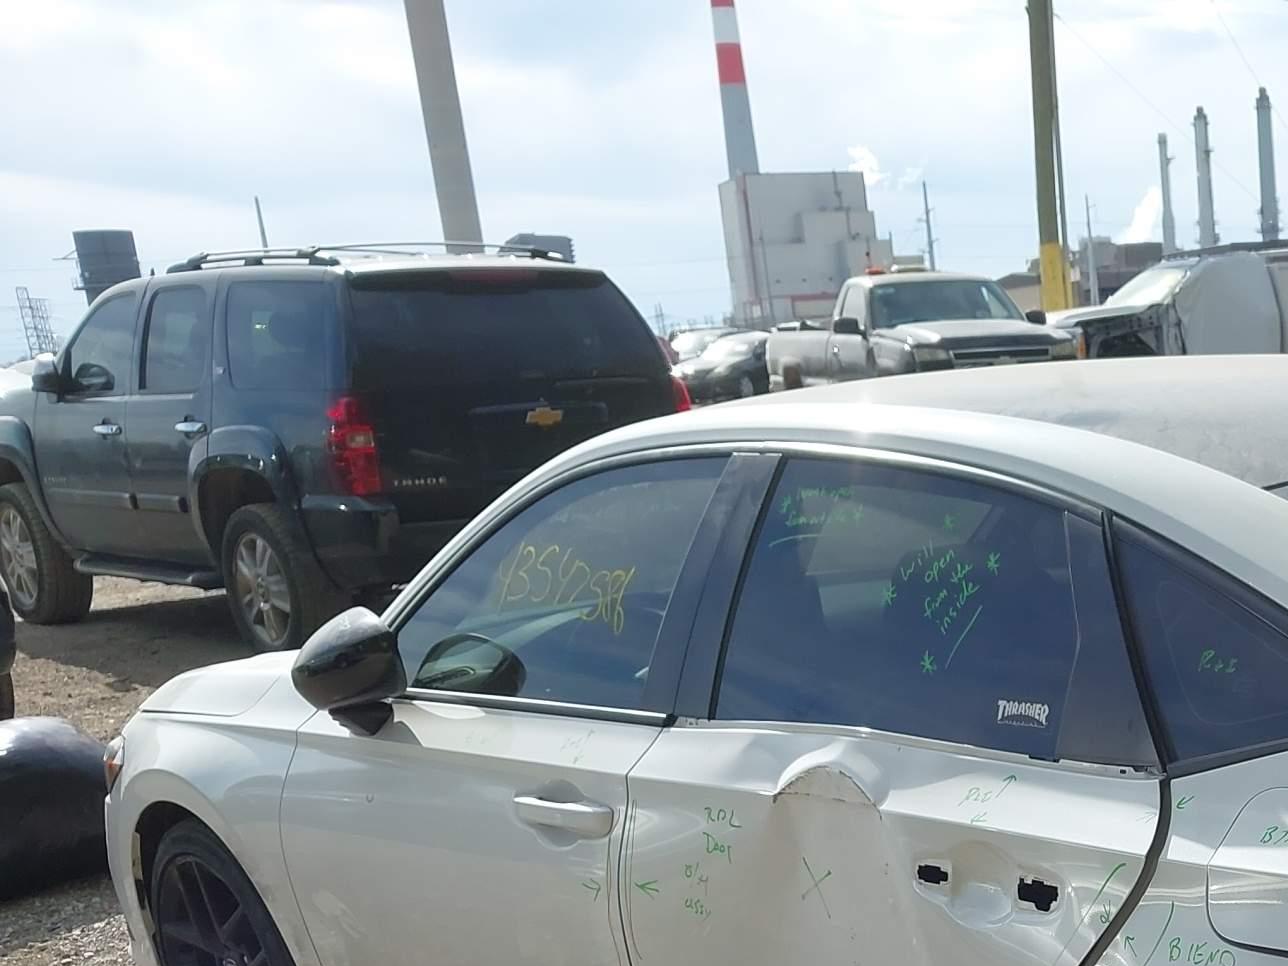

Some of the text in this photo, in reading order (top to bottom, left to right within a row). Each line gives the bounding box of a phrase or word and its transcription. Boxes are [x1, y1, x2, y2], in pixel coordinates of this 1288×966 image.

[924, 549, 955, 583] open
[939, 577, 981, 636] inside
[997, 699, 1049, 726] THRASHER
